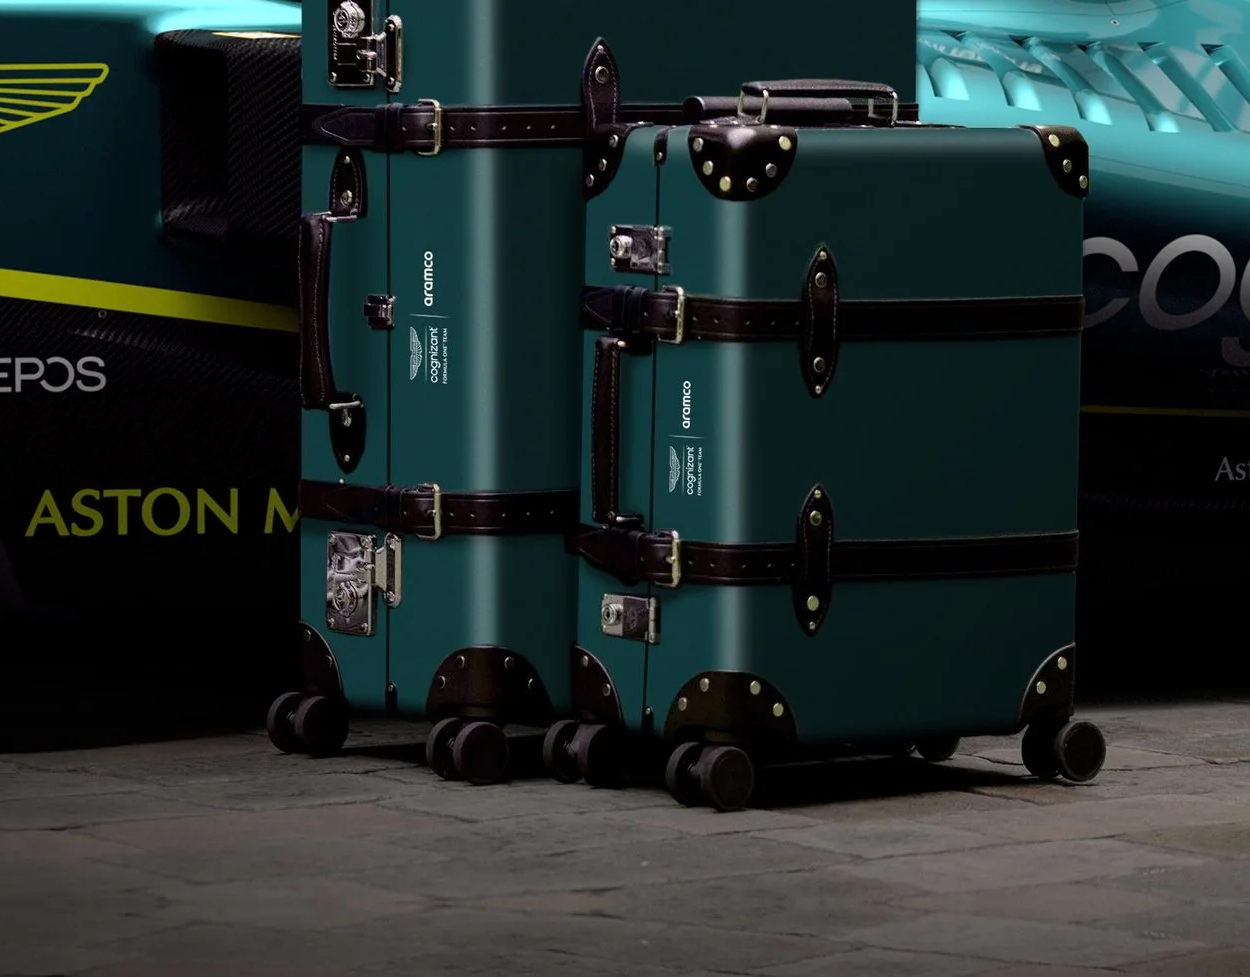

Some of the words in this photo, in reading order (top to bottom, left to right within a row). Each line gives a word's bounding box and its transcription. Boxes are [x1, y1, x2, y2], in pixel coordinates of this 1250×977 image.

[423, 250, 434, 307] aramco
[428, 327, 441, 383] cognizant
[682, 380, 692, 429] aramco
[686, 446, 696, 495] cognizant
[24, 487, 240, 537] ASTON
